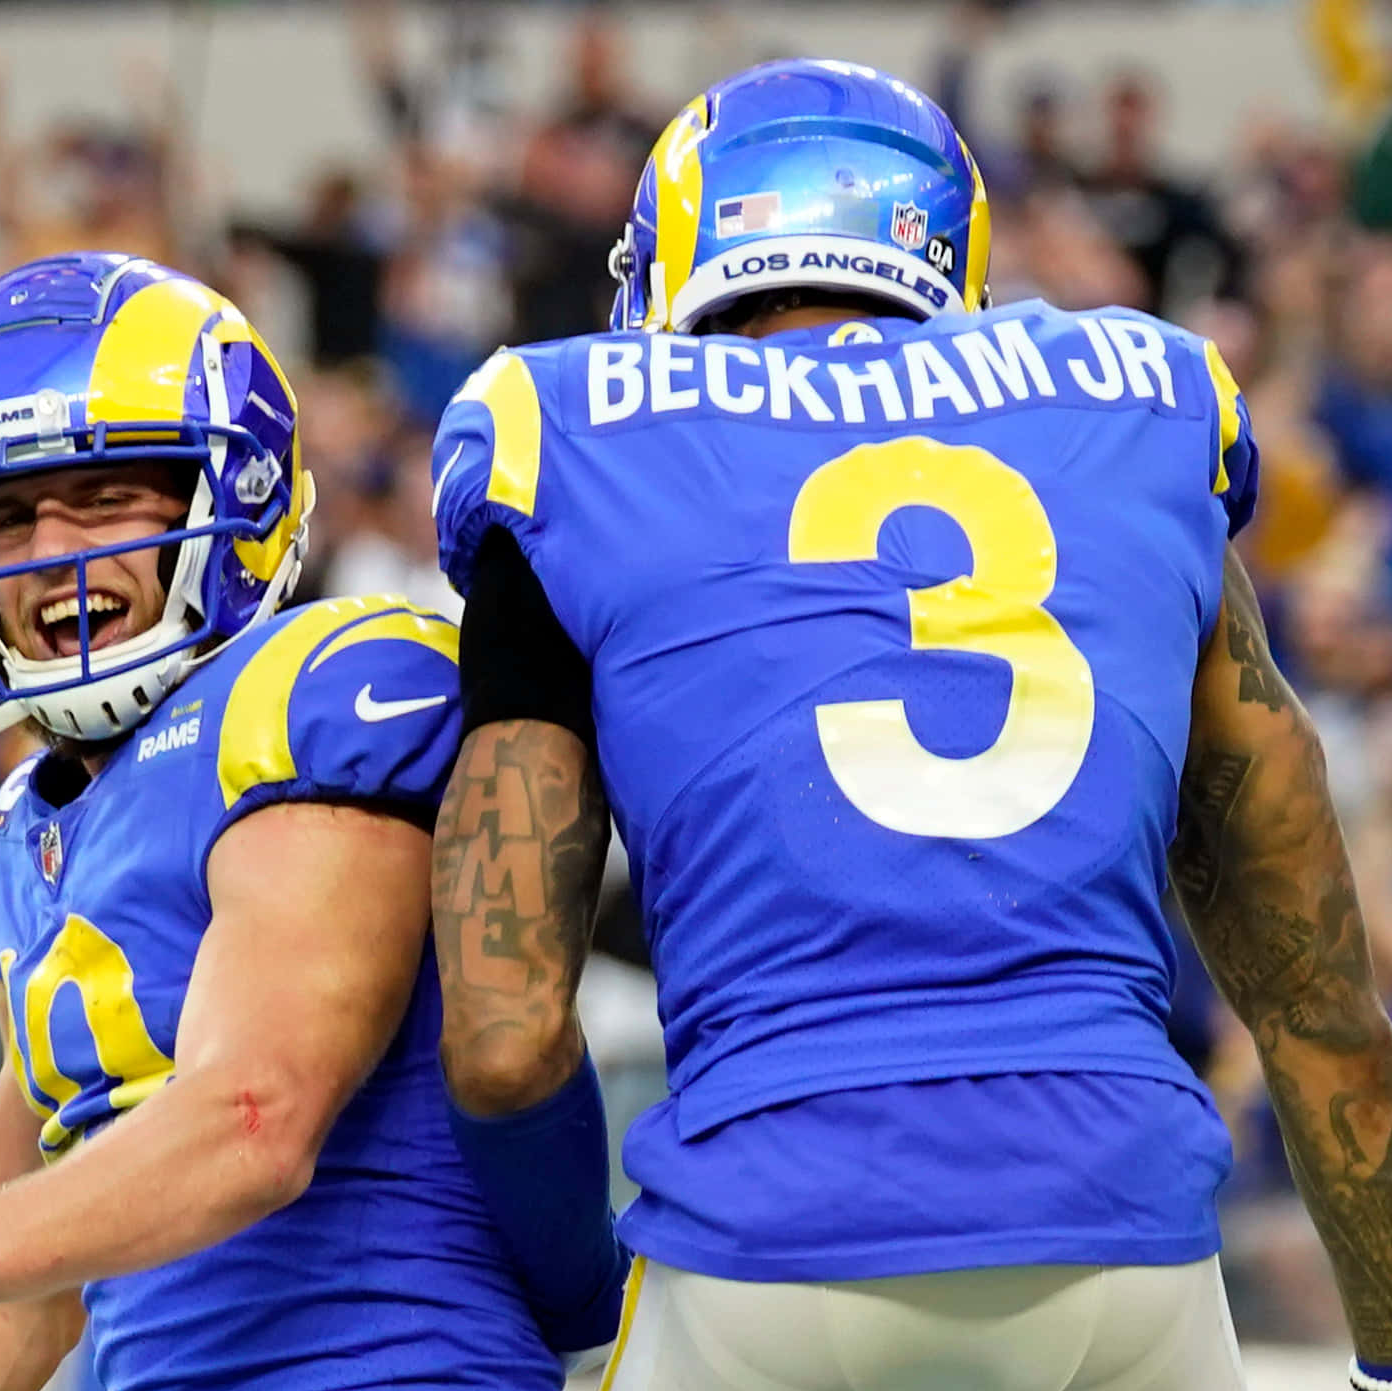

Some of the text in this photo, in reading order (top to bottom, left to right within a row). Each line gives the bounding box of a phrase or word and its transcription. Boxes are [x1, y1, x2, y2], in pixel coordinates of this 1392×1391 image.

[896, 221, 922, 244] NFL
[722, 251, 950, 310] LOS ANGELES
[587, 317, 1179, 427] BECKHAM JR
[787, 434, 1096, 840] 3
[136, 717, 201, 763] RAMS
